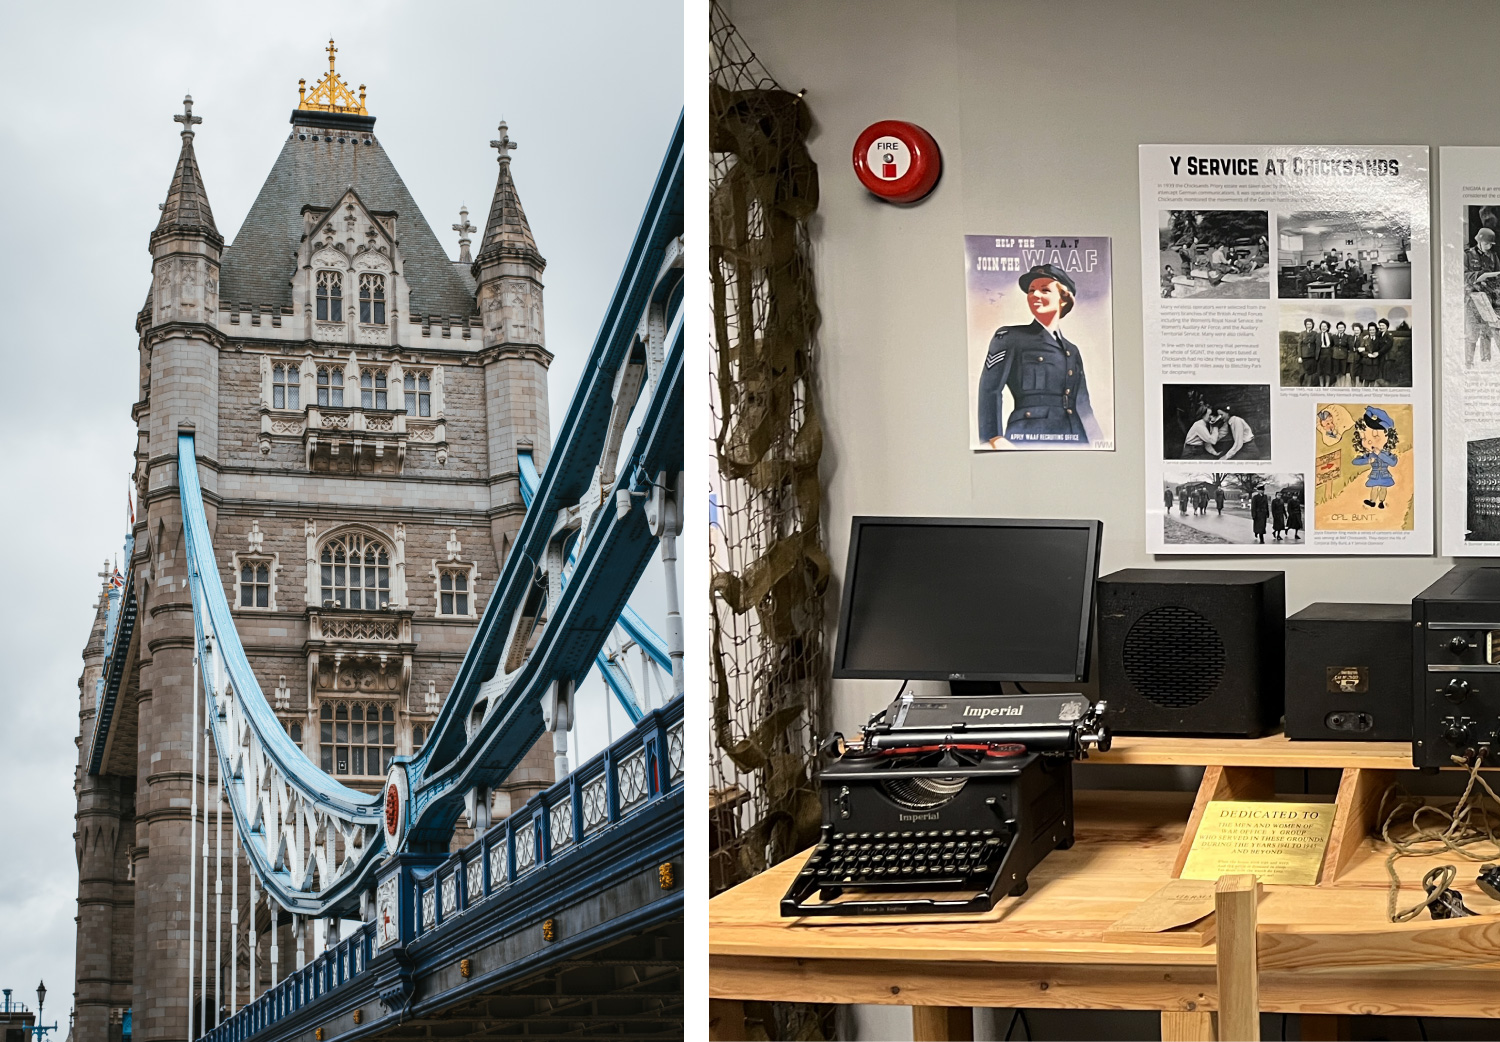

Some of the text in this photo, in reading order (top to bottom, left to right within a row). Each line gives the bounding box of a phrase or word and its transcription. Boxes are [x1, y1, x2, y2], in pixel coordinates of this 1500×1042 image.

[877, 142, 899, 150] FIRE
[1169, 156, 1181, 175] Y
[1264, 159, 1287, 176] AT
[995, 238, 1015, 248] HELP
[1018, 238, 1035, 248] THE
[976, 249, 1098, 273] JOIN THE WAAF
[1331, 513, 1348, 521] CPL
[962, 705, 1024, 719] Imperial
[899, 811, 940, 823] Imperial
[1219, 810, 1319, 820] DEDICATED TO
